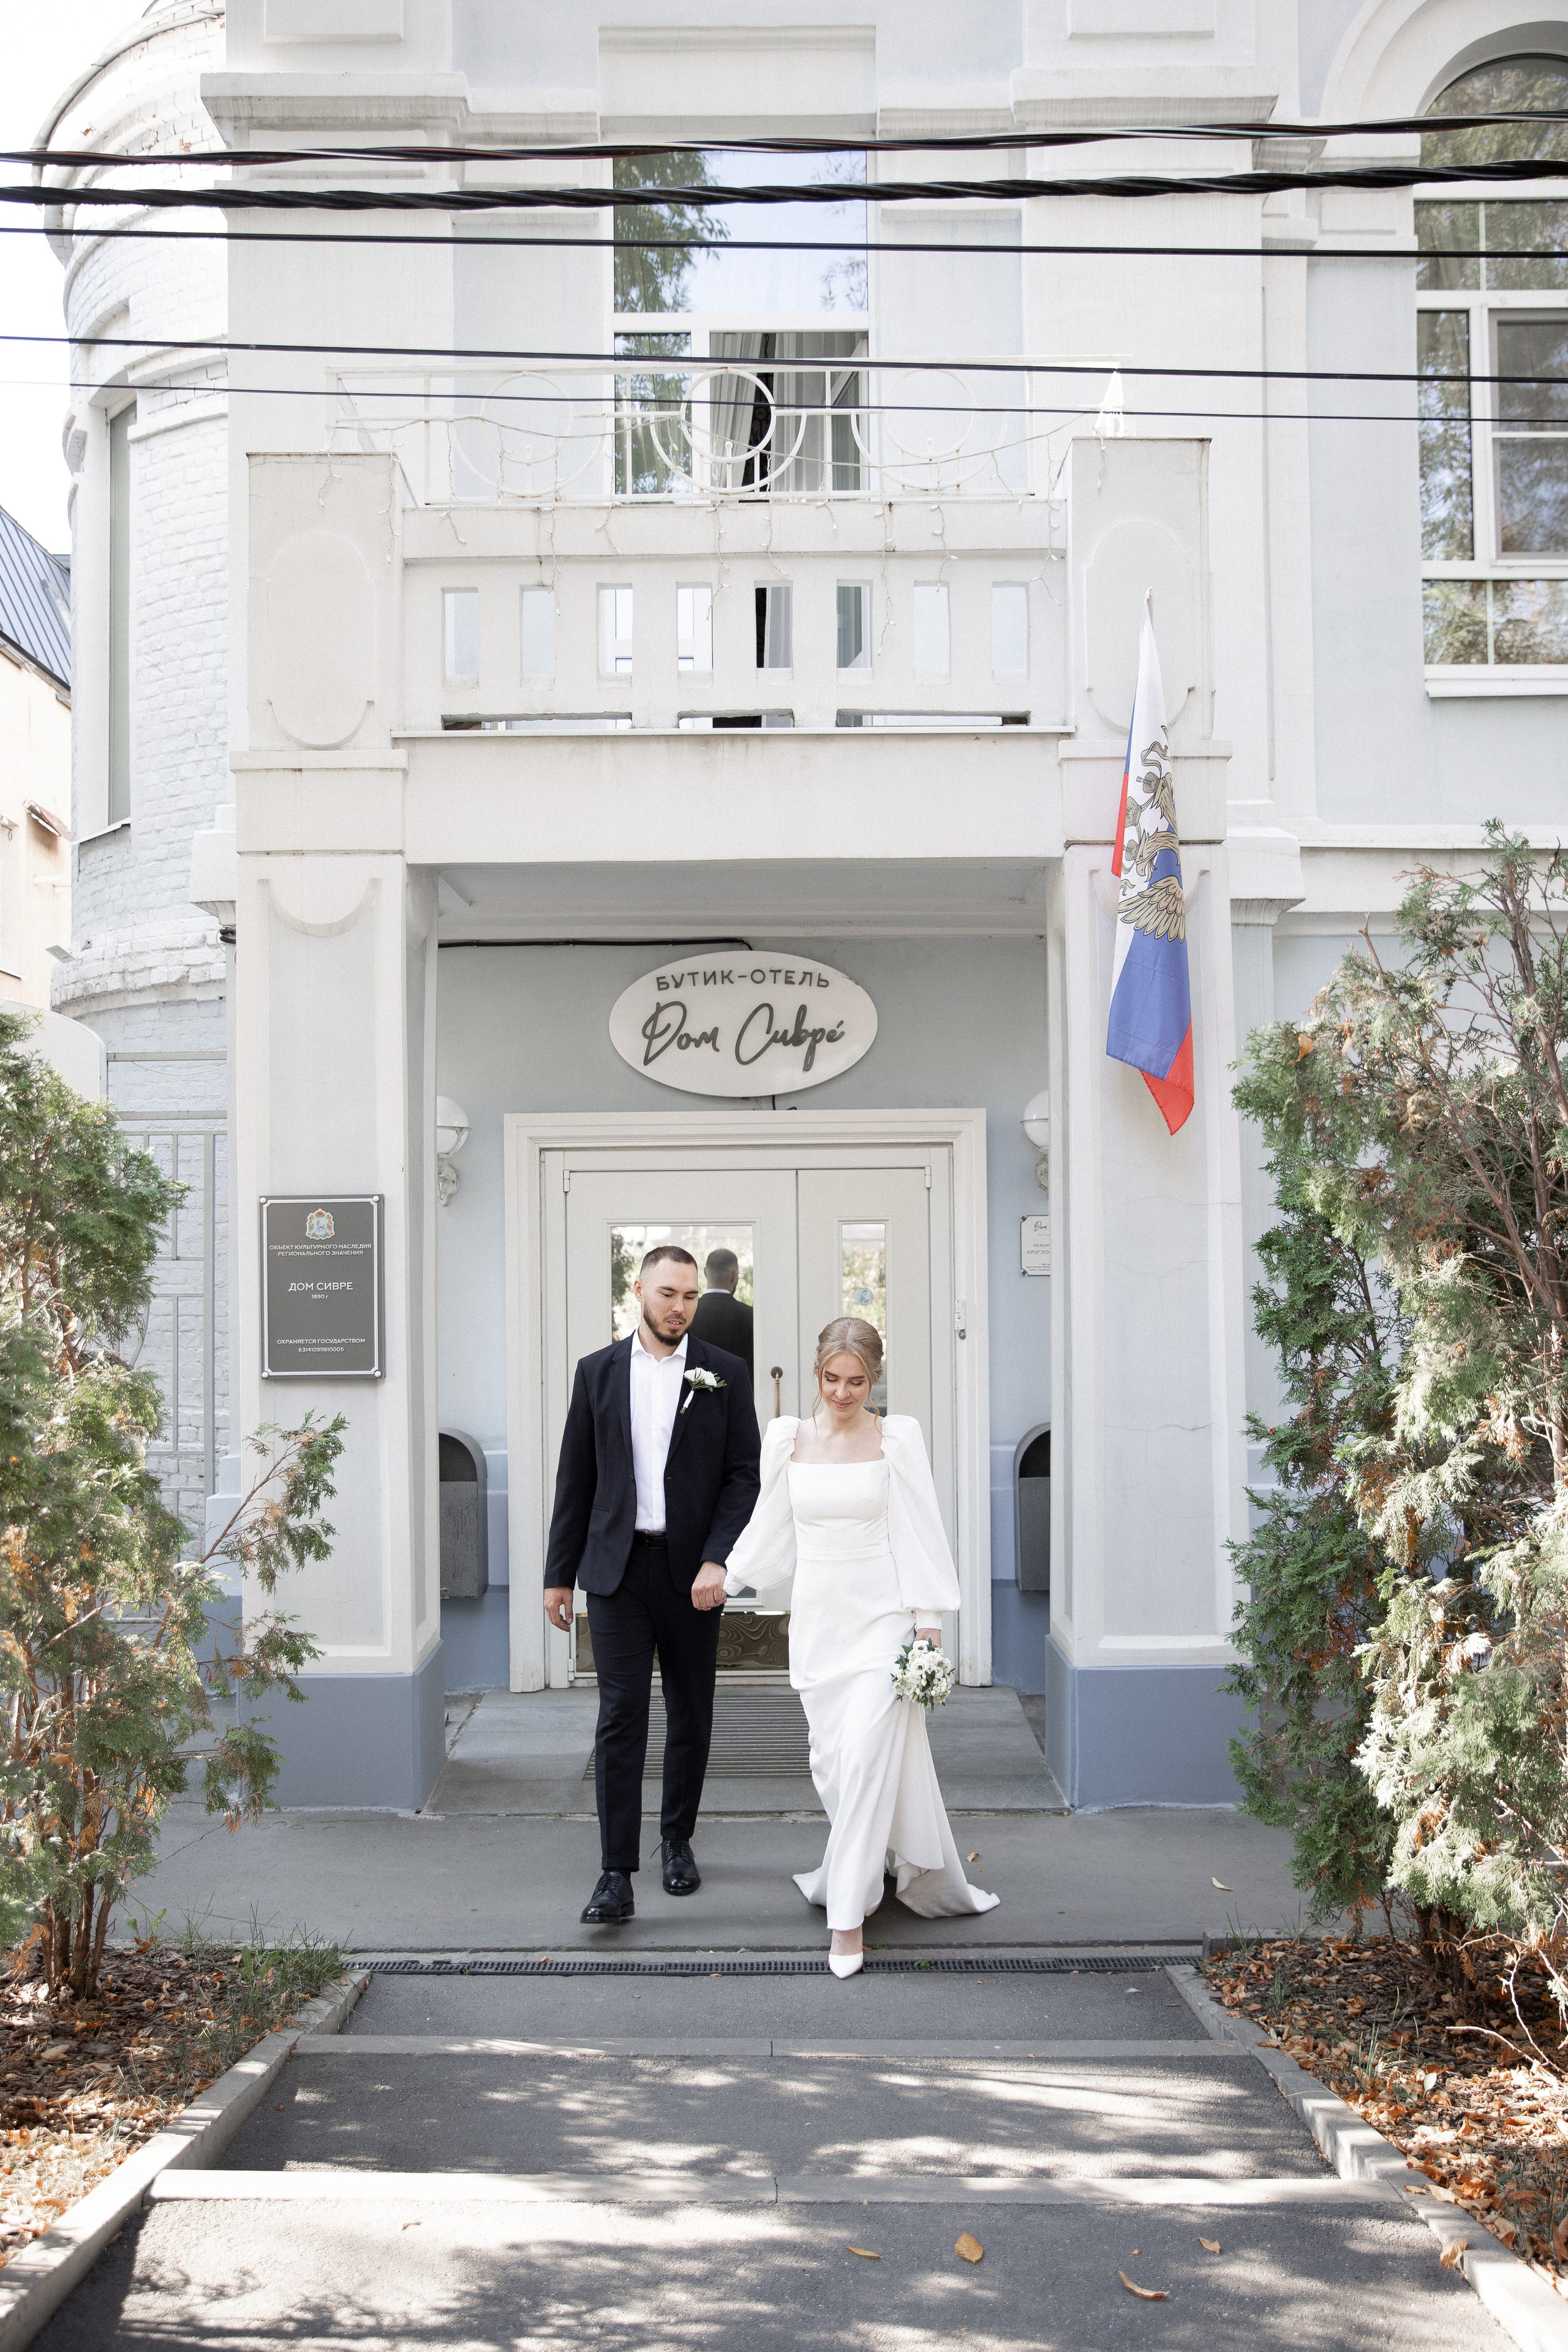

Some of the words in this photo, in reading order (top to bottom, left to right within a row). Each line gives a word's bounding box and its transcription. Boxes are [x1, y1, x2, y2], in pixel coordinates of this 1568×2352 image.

[655, 968, 830, 992] БУТИК-ОТЕЛЬ
[641, 1001, 720, 1066] Дом
[288, 1283, 314, 1292] ДОМ
[316, 1282, 353, 1291] СИВРЕ
